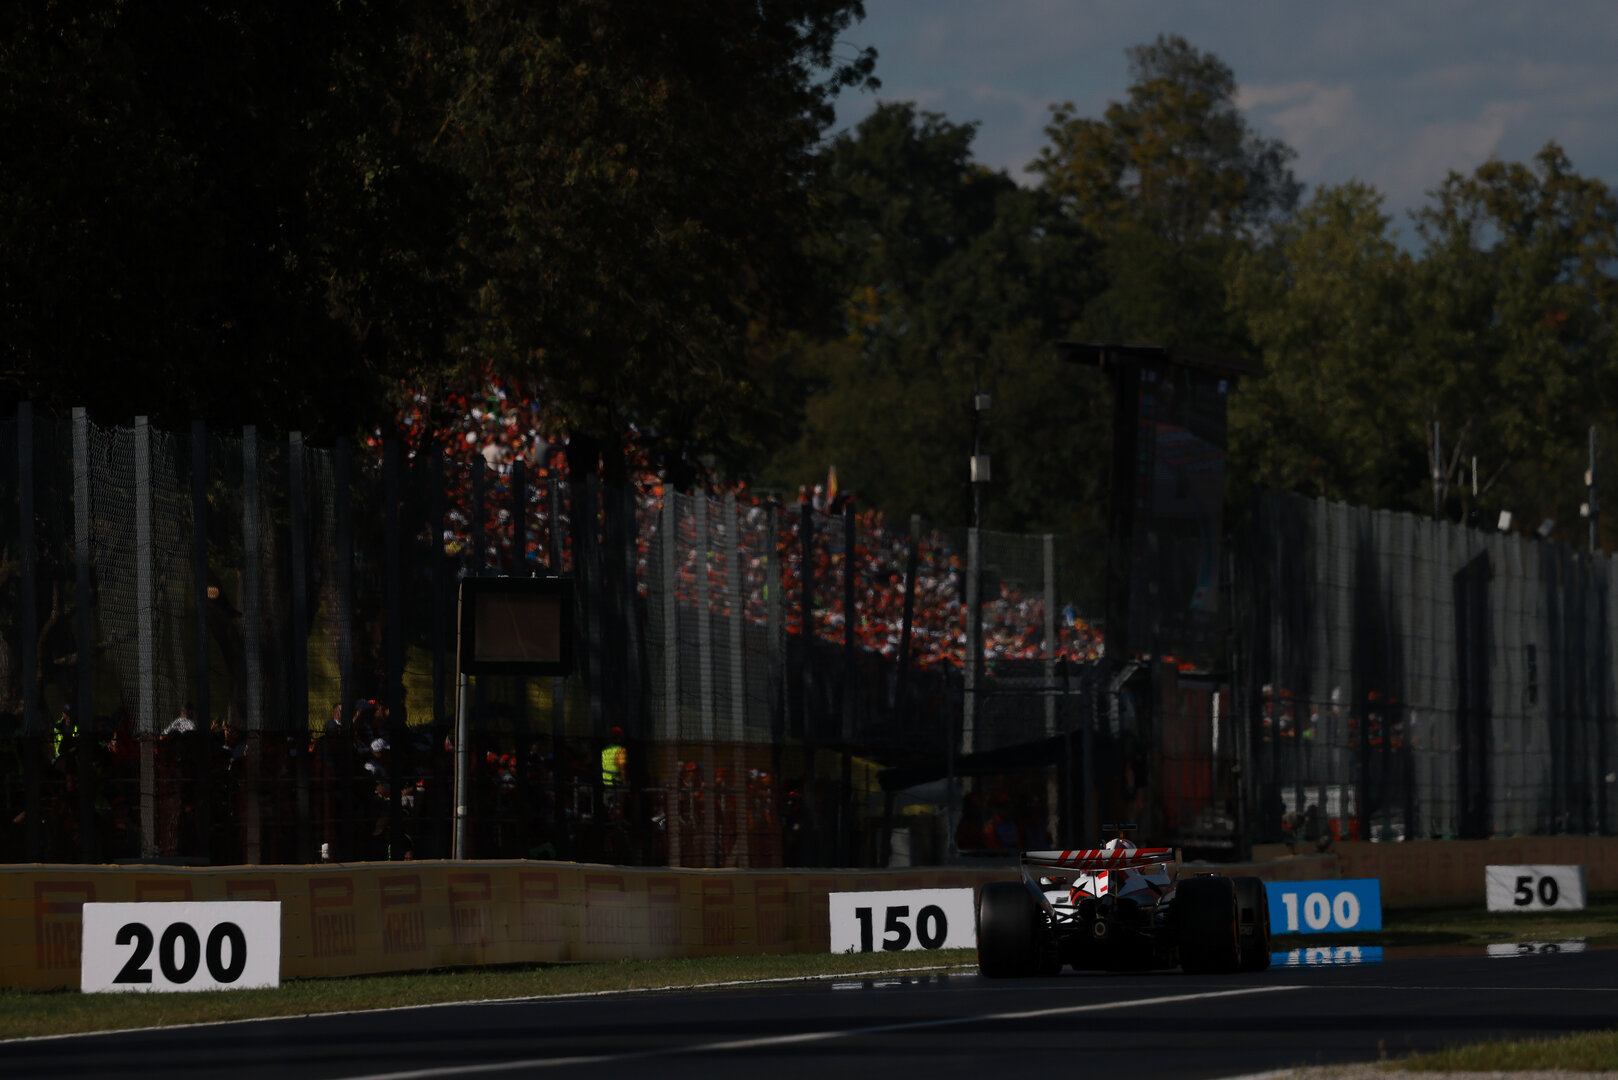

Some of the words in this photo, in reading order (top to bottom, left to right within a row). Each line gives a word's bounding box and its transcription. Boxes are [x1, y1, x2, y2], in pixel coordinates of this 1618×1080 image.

[1281, 891, 1361, 932] 100
[1514, 876, 1559, 907] 50
[855, 904, 948, 953] 150
[112, 921, 247, 984] 200
